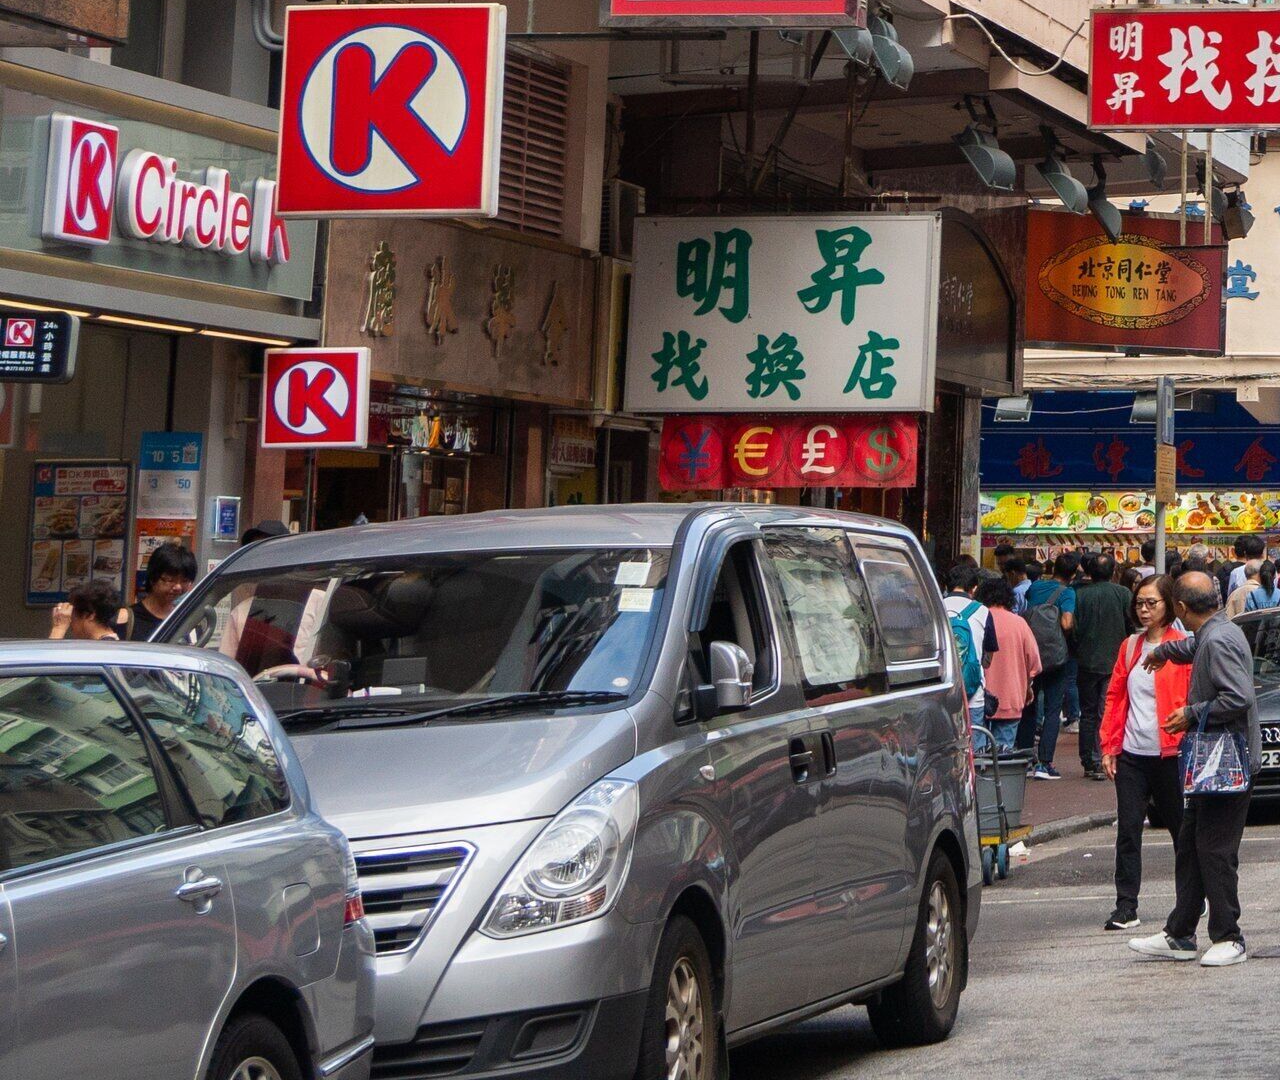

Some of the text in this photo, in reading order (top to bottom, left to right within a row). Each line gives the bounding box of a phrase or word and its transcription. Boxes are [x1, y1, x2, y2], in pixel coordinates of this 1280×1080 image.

[328, 38, 440, 180] K
[1105, 21, 1145, 115] 明昇
[135, 154, 251, 251] Circle
[676, 226, 885, 324] 明昇
[1077, 255, 1173, 285] 北京同仁堂
[1105, 284, 1126, 300] TONG
[1133, 286, 1149, 301] REN
[1156, 288, 1177, 303] TANG
[287, 367, 346, 428] K
[651, 331, 900, 401] 找換店
